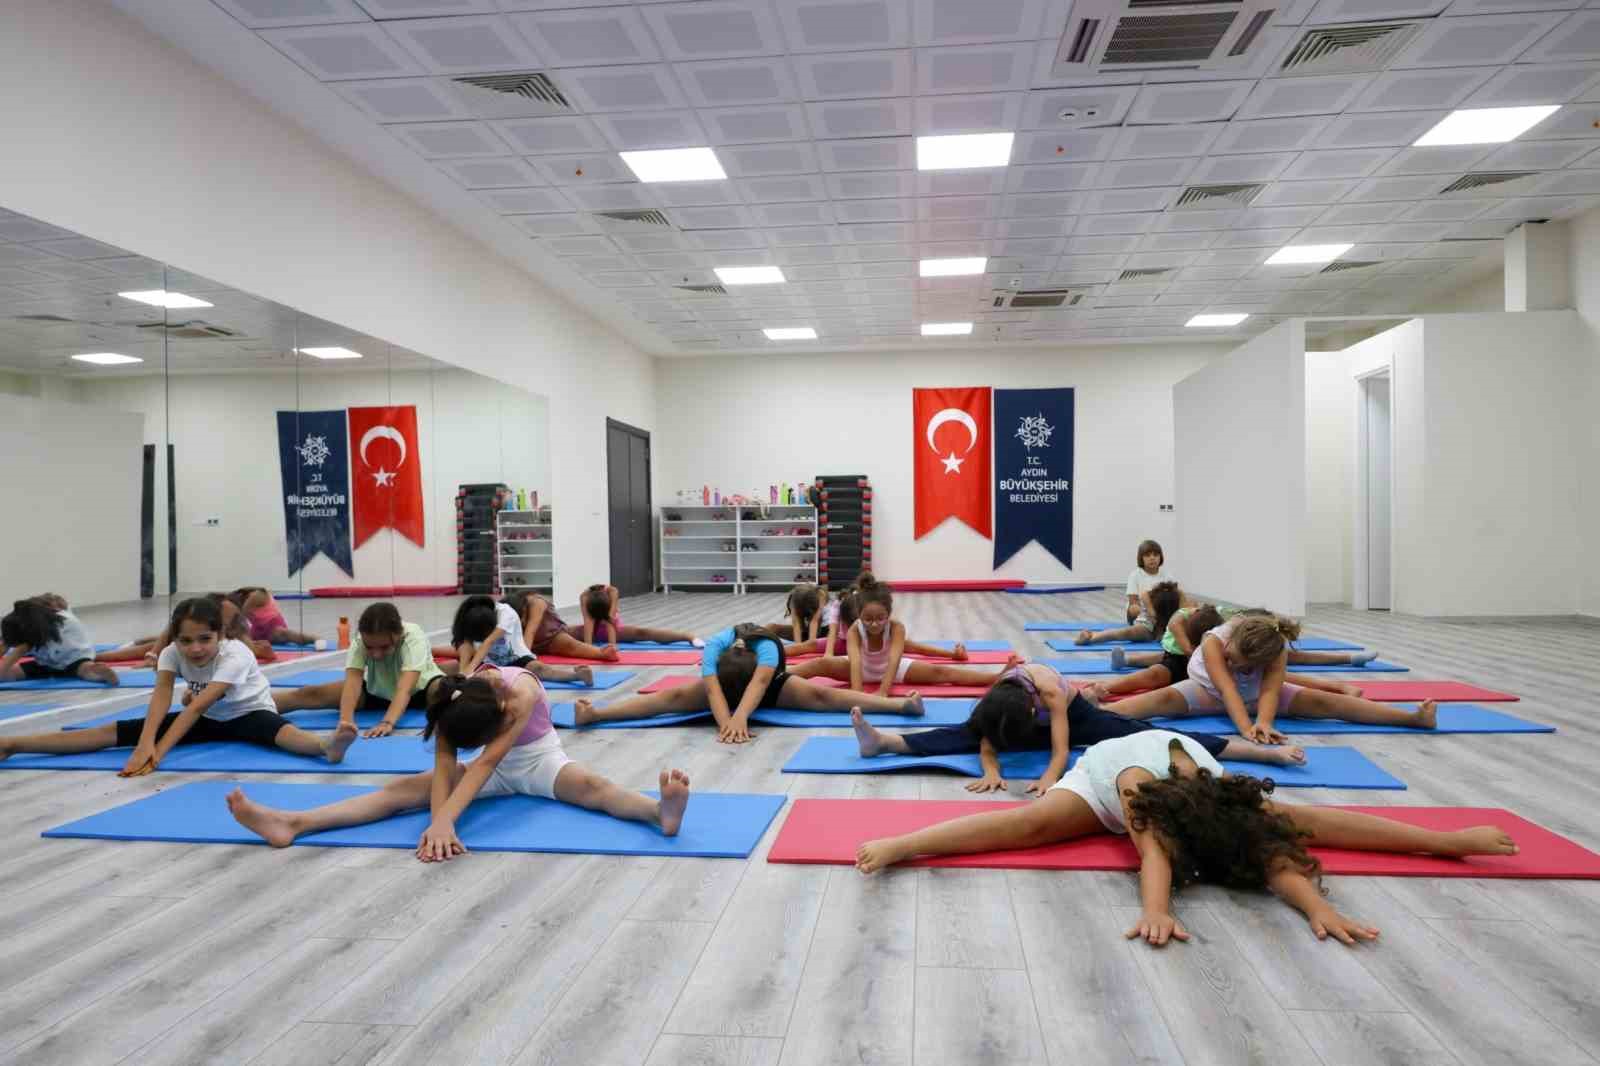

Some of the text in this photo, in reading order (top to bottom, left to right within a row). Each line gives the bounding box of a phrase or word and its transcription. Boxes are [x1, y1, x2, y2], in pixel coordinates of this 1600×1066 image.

[1026, 456, 1042, 465] T.C.
[1021, 468, 1048, 477] AYDIN
[1000, 478, 1069, 493] BÜYÜKŞEHİR
[1009, 493, 1058, 503] BELEDİYESİ
